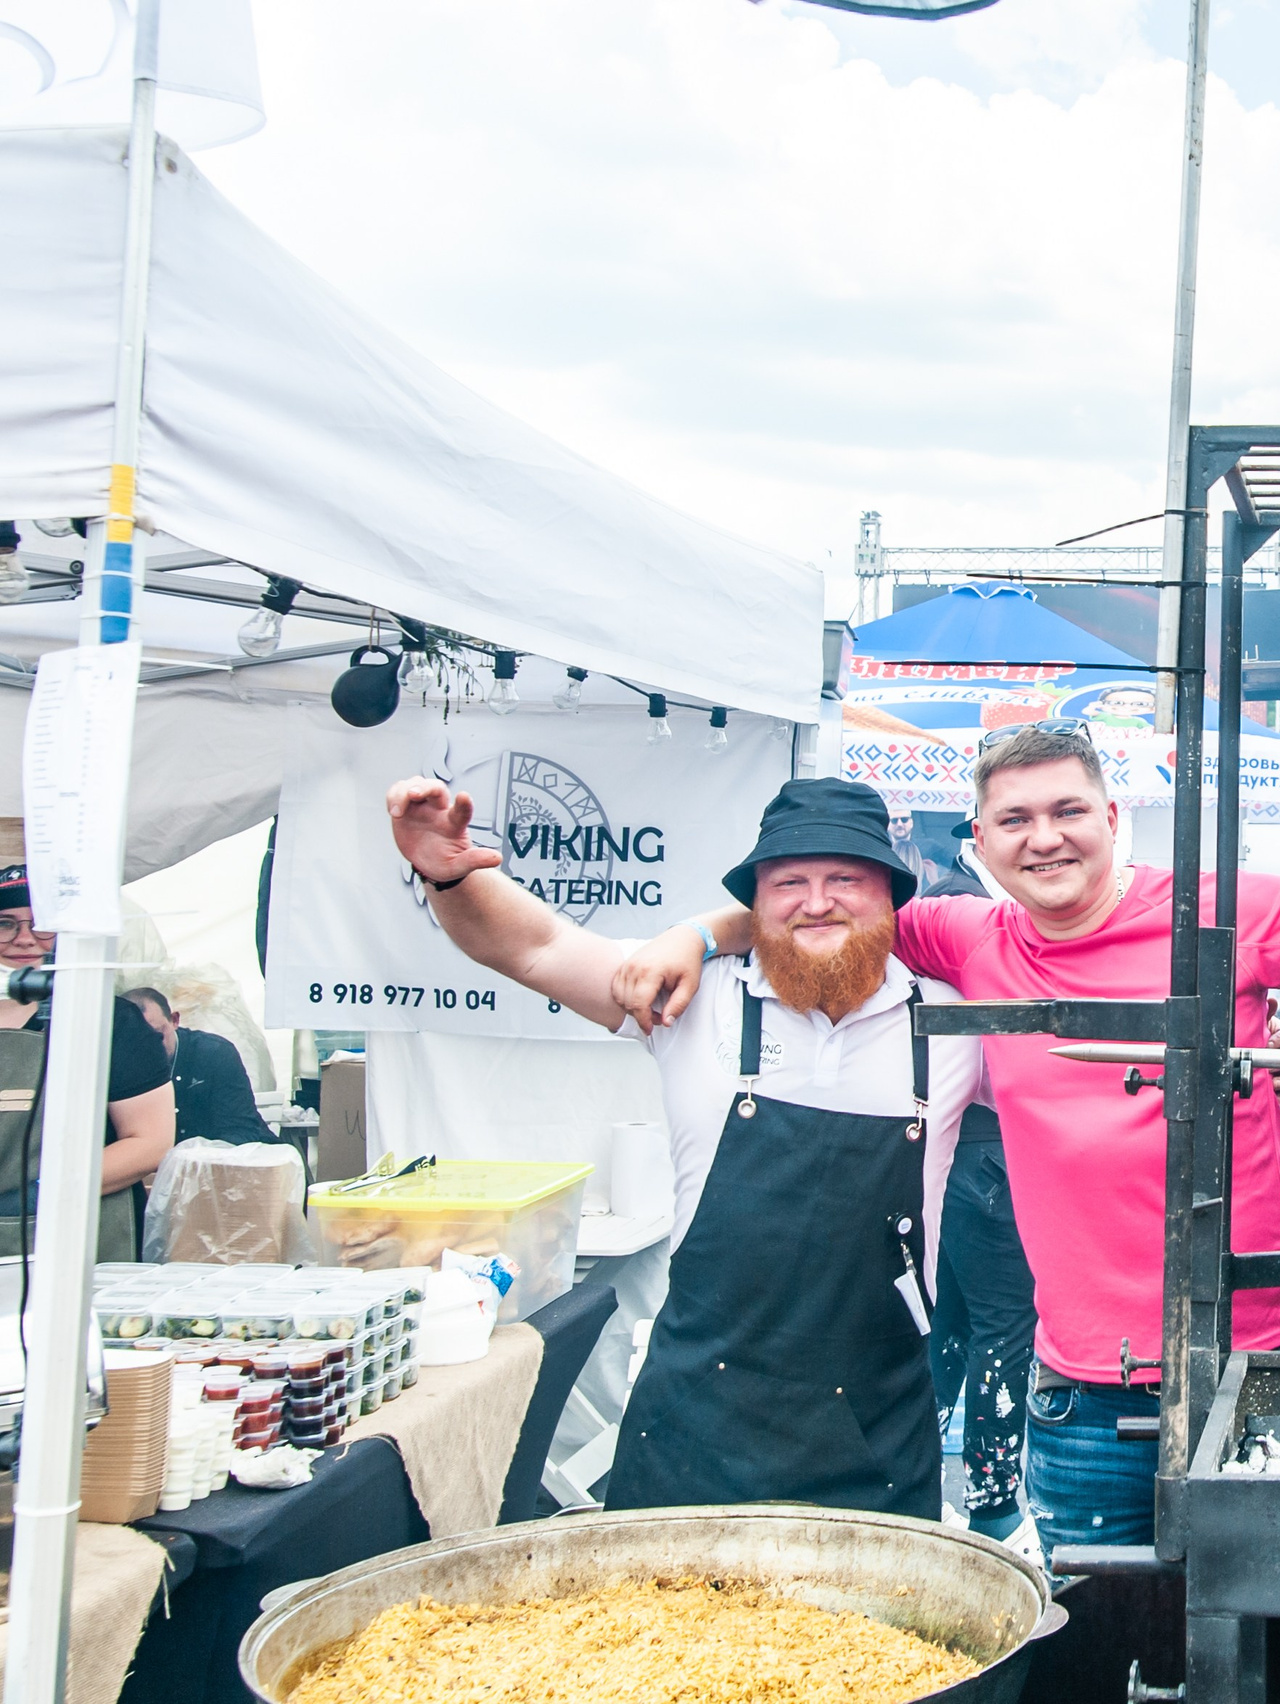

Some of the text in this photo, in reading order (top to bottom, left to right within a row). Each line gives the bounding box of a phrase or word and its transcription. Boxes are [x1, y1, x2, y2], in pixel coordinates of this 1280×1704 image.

[508, 823, 665, 862] VIKING
[309, 983, 496, 1011] 8 918 977 10 04
